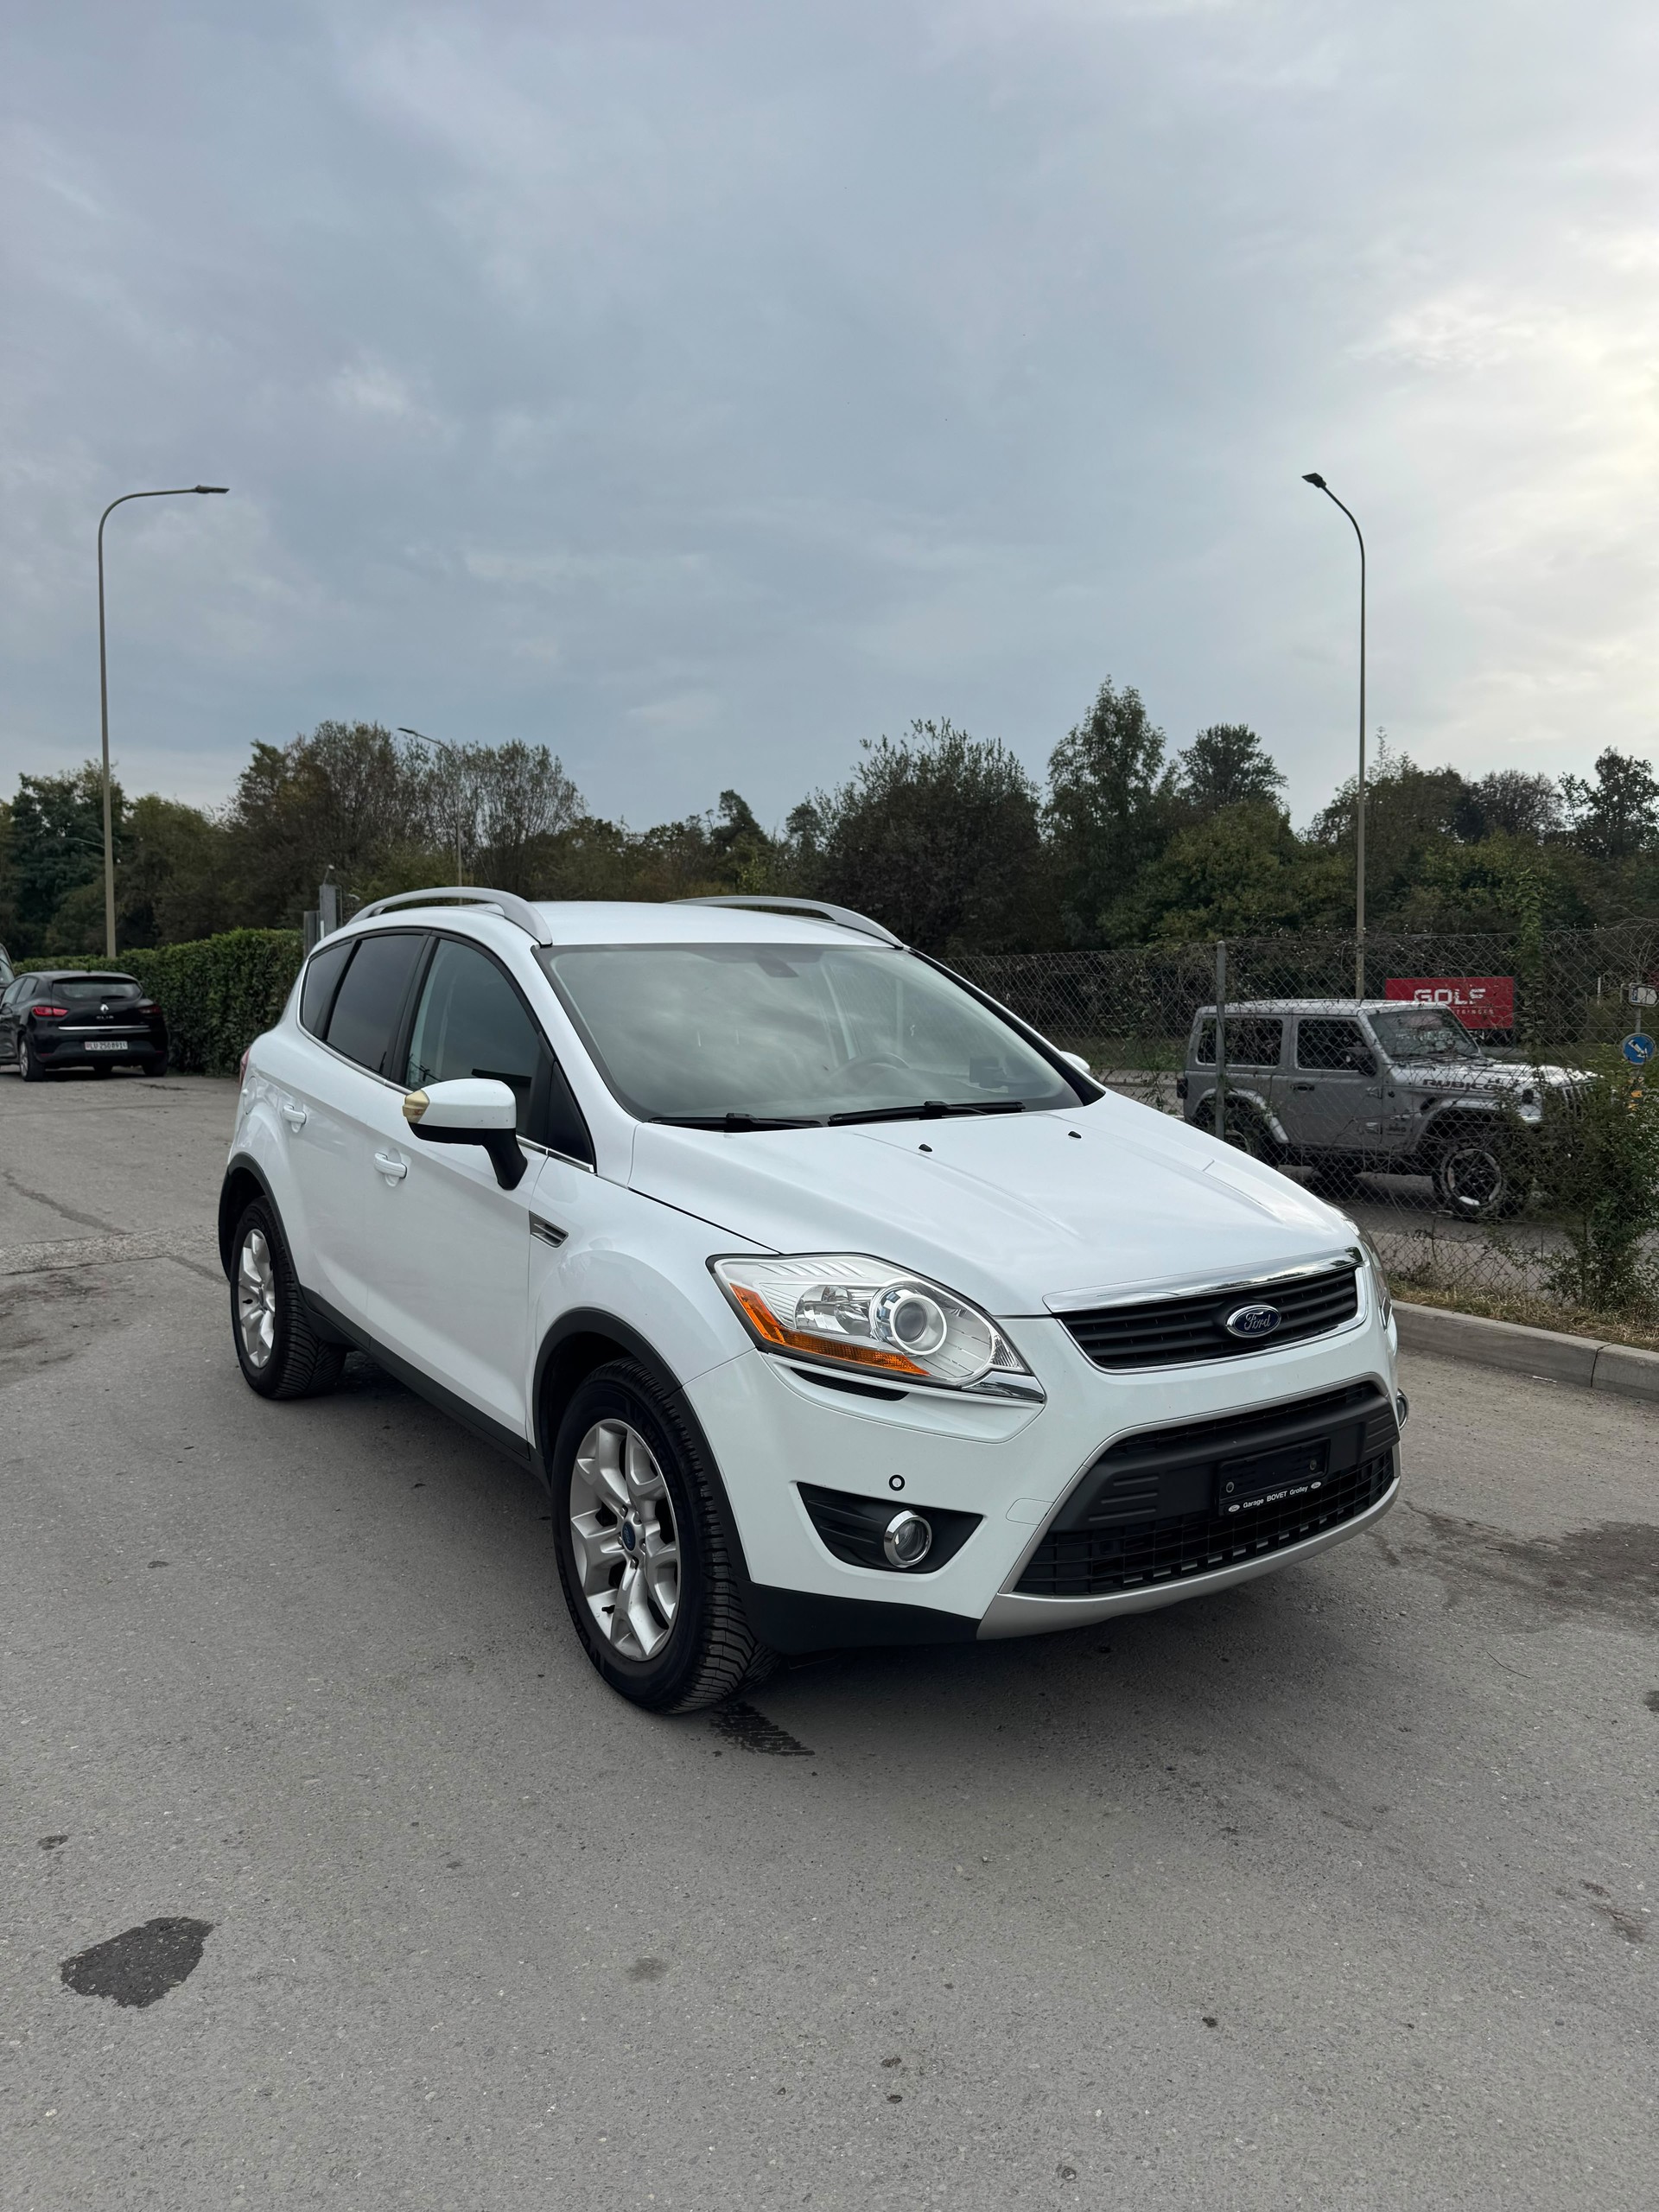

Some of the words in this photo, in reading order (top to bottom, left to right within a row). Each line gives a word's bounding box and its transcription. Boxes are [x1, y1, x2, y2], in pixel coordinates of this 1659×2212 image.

[1414, 988, 1486, 1005] GOLF
[1422, 1079, 1503, 1093] RUBICO
[1243, 1311, 1271, 1331] Ford
[1243, 1498, 1264, 1509] Garage
[1266, 1491, 1287, 1503] BOVET
[1289, 1485, 1309, 1496] Grolley
